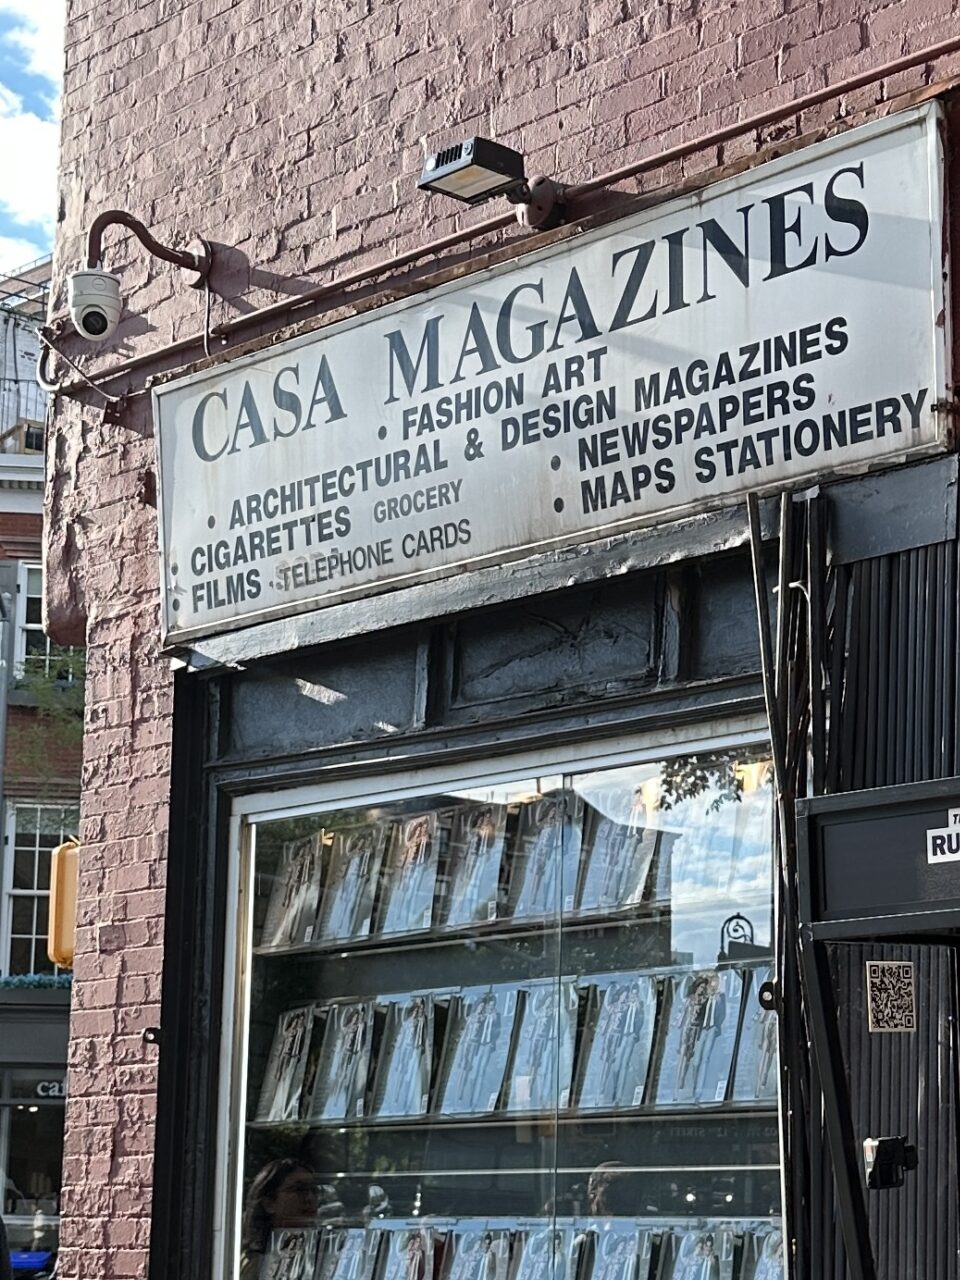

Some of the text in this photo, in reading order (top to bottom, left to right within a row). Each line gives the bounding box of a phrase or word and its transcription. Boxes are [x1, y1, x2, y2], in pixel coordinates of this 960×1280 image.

[192, 160, 869, 463] CASA MAGAZINES
[229, 316, 849, 531] ARCHITECTURAL & DESIGN MAGAZINES
[402, 346, 608, 441] FASHION ART
[578, 373, 815, 472] NEWSPAPERS
[581, 388, 929, 514] MAPS STATIONERY
[191, 479, 463, 577] CIGARETTES GROCERY
[192, 518, 472, 614] FILMS TELEPHONE CARDS
